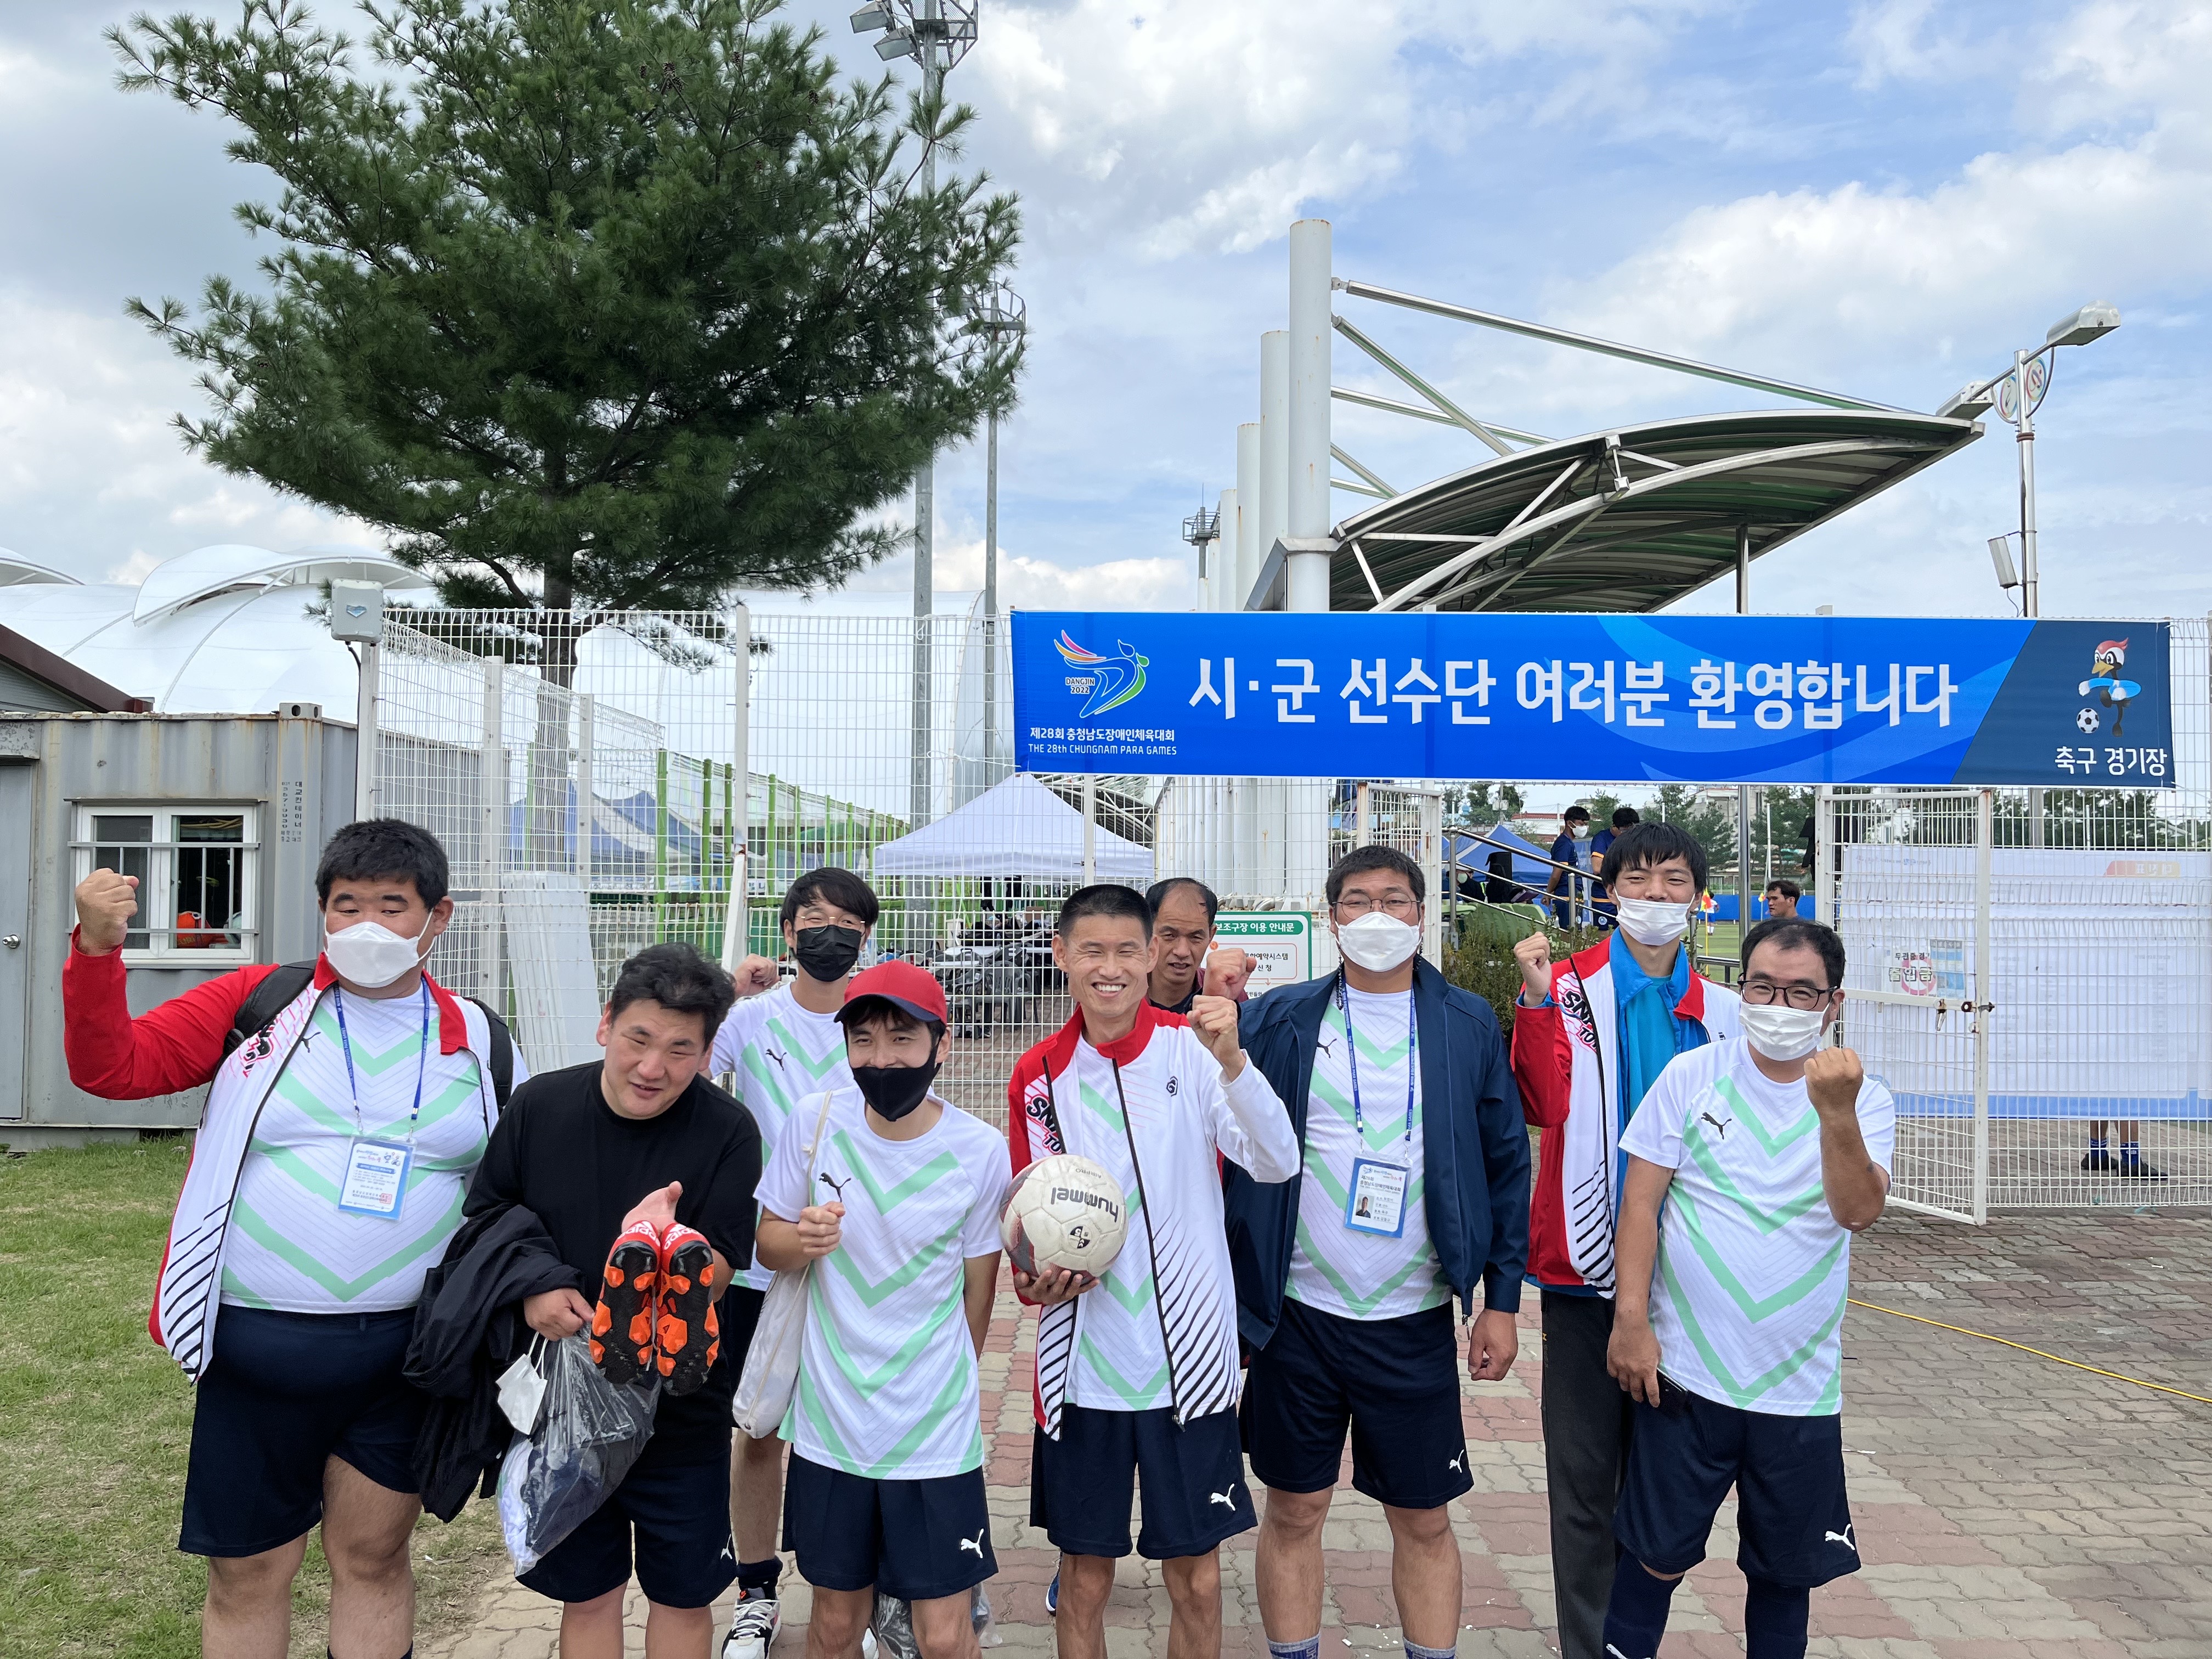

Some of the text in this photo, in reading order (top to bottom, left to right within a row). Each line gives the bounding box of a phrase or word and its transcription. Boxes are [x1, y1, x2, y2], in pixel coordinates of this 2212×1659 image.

[1065, 677, 1095, 685] DANGJIN
[1070, 686, 1090, 694] 2022
[1340, 658, 1496, 725] 선수단
[1516, 660, 1669, 726] 여러분
[1689, 659, 1958, 730] 환영합니다
[1030, 727, 1175, 742] 제28회 충청남도장애인체육대회
[1028, 743, 1177, 755] THE 28th CHUNGNAM PARA GAMES
[2055, 746, 2168, 776] 축구 경기장
[1250, 922, 1267, 933] 이용
[1269, 923, 1295, 932] 안내문
[1051, 1187, 1119, 1223] hummel
